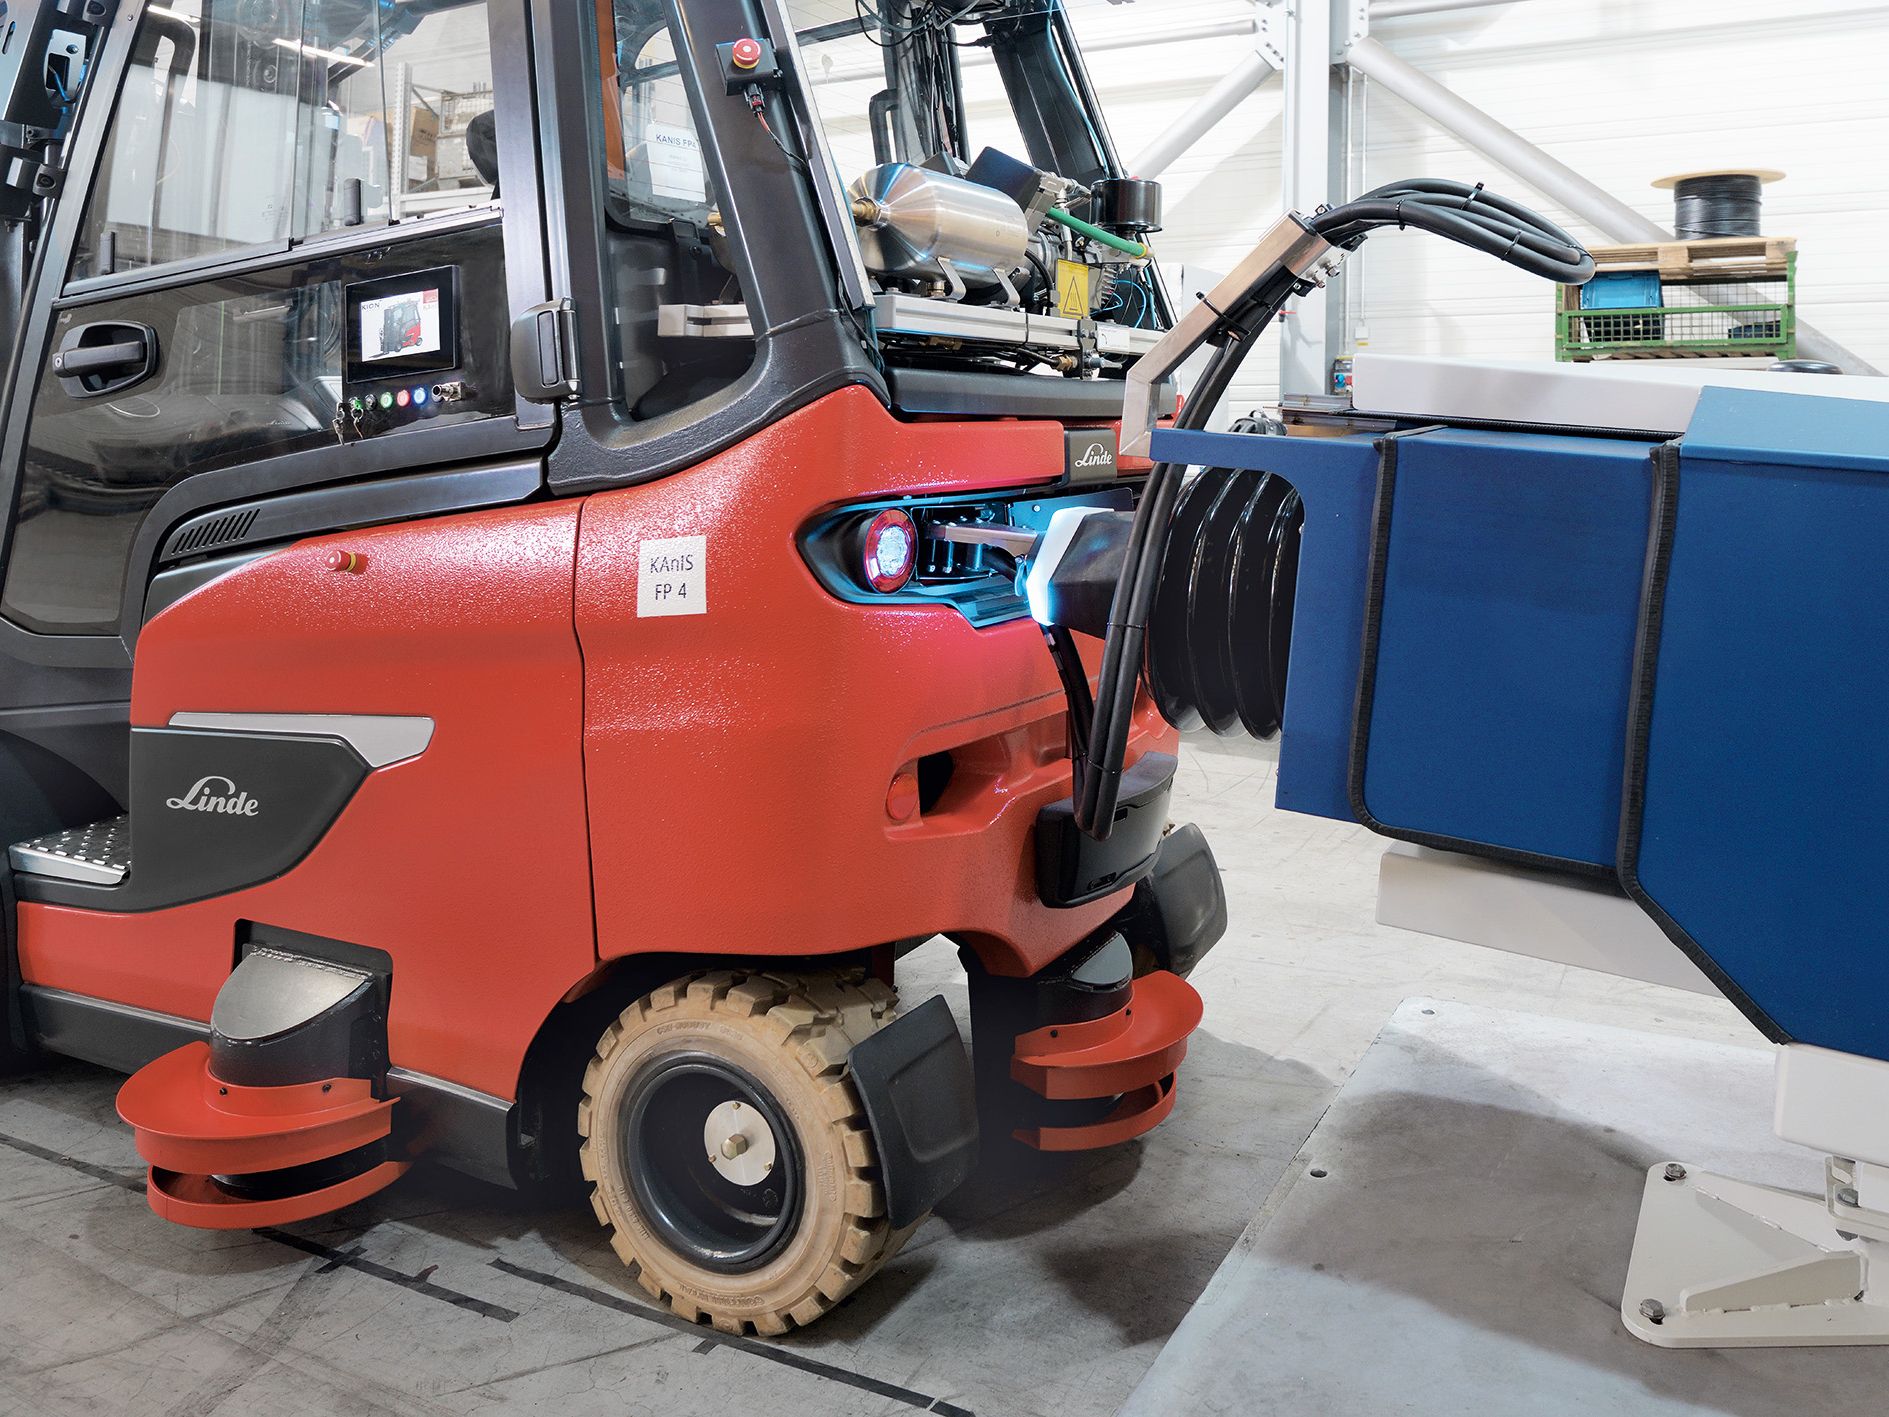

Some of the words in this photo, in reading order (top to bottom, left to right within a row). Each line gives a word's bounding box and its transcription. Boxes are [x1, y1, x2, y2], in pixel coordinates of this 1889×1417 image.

[1074, 443, 1112, 467] Linde
[655, 583, 672, 600] FP
[678, 582, 687, 599] 4
[166, 775, 259, 816] Linde
